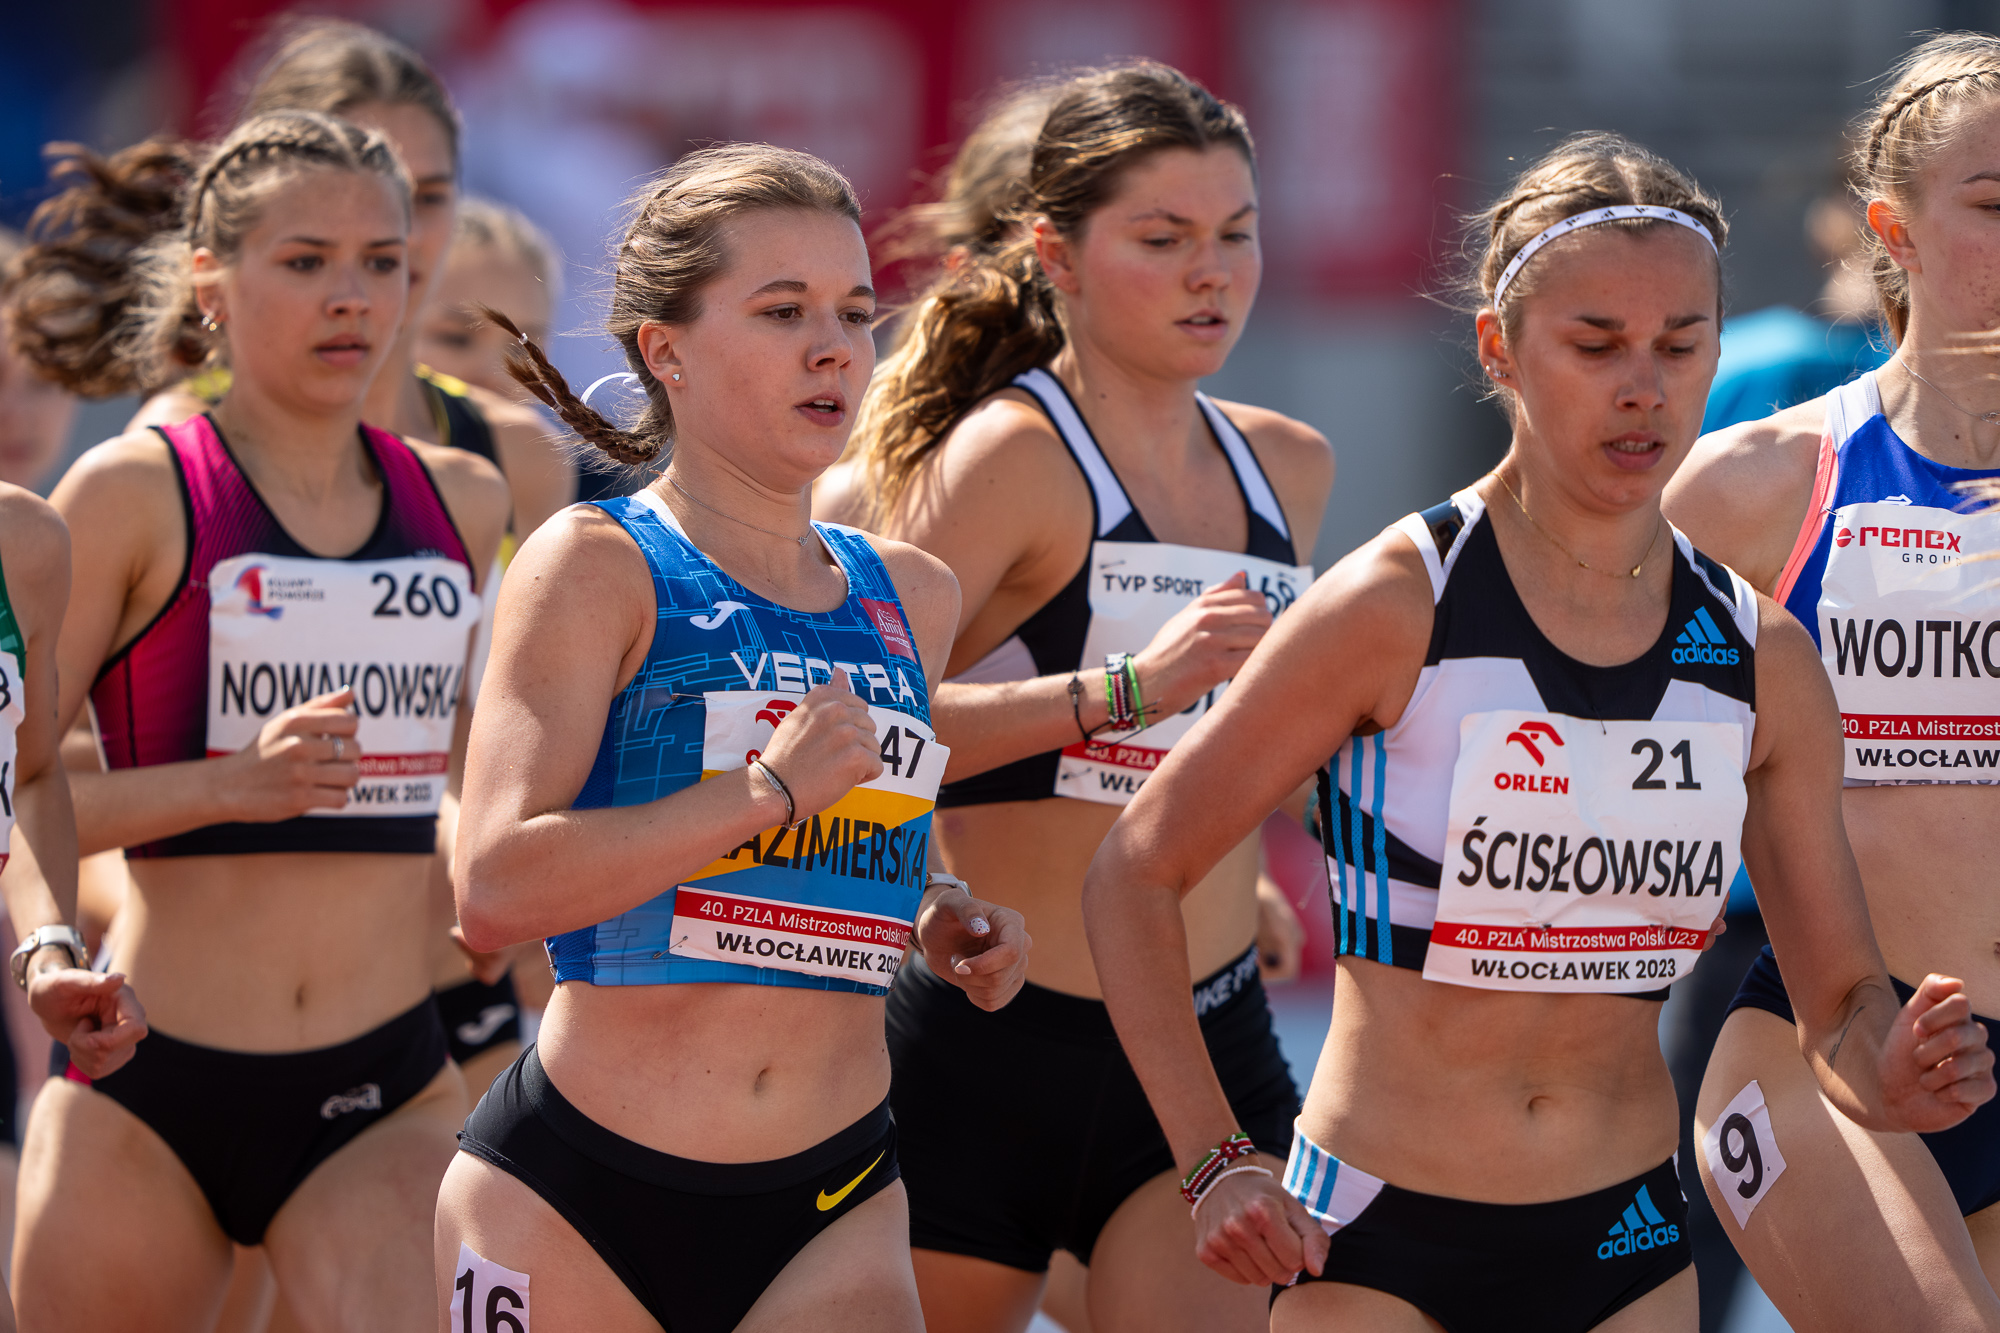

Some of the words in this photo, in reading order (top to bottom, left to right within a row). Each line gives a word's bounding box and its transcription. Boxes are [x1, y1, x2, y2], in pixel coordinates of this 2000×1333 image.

[372, 571, 460, 618] 260
[1103, 574, 1147, 592] TVP
[1153, 575, 1204, 597] SPORT
[1671, 643, 1740, 666] adidas
[730, 651, 918, 707] VECTRA
[1869, 720, 1912, 736] PZLA
[1115, 748, 1157, 768] PZLA
[1631, 738, 1702, 790] 21
[1494, 772, 1569, 794] ORLEN
[721, 814, 927, 890] AZIMIERSKA
[1457, 816, 1723, 897] ŚCISŁOWSKA
[700, 901, 727, 918] 40.
[733, 905, 774, 925] PZLA
[779, 912, 872, 939] Mistrzostwa
[875, 925, 901, 944] Polski
[1455, 928, 1483, 946] 40.
[1487, 930, 1525, 948] PZLA
[1530, 931, 1626, 949] Mistrzostwa
[1629, 929, 1666, 947] Polski
[1668, 931, 1699, 946] U23
[716, 931, 873, 970] WŁOCŁAWEK
[1471, 958, 1630, 981] WŁOCŁAWEK
[1635, 957, 1676, 979] 2023
[1719, 1112, 1764, 1199] 9
[1597, 1223, 1680, 1260] adidas
